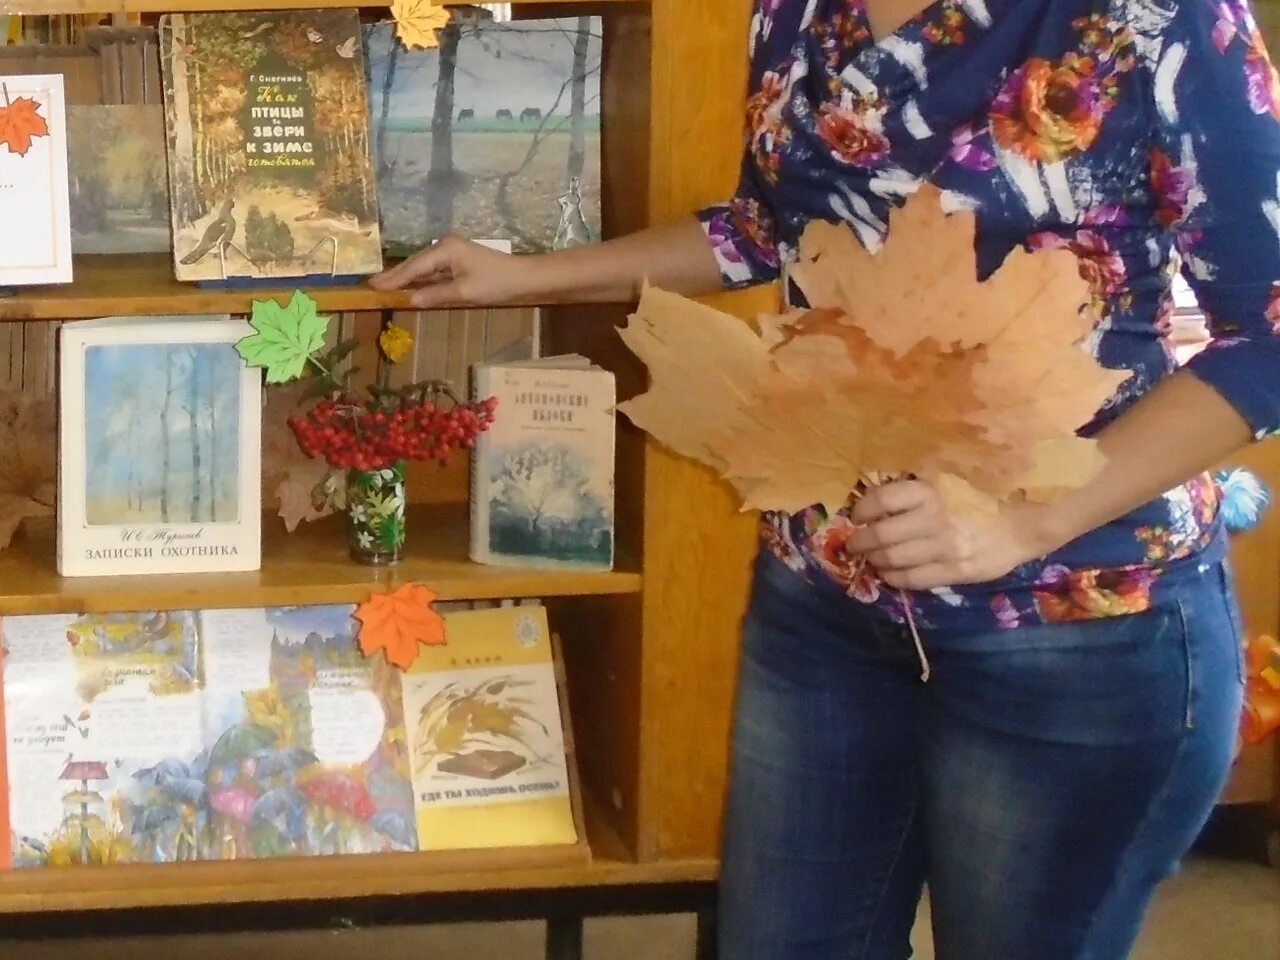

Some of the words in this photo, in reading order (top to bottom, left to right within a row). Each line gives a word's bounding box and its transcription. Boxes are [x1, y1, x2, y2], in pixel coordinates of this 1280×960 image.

[256, 85, 298, 102] Как
[251, 106, 304, 119] ПТИЦЫ
[85, 548, 152, 559] ЗАПИСКИ
[161, 545, 238, 557] ОХОТНИКА
